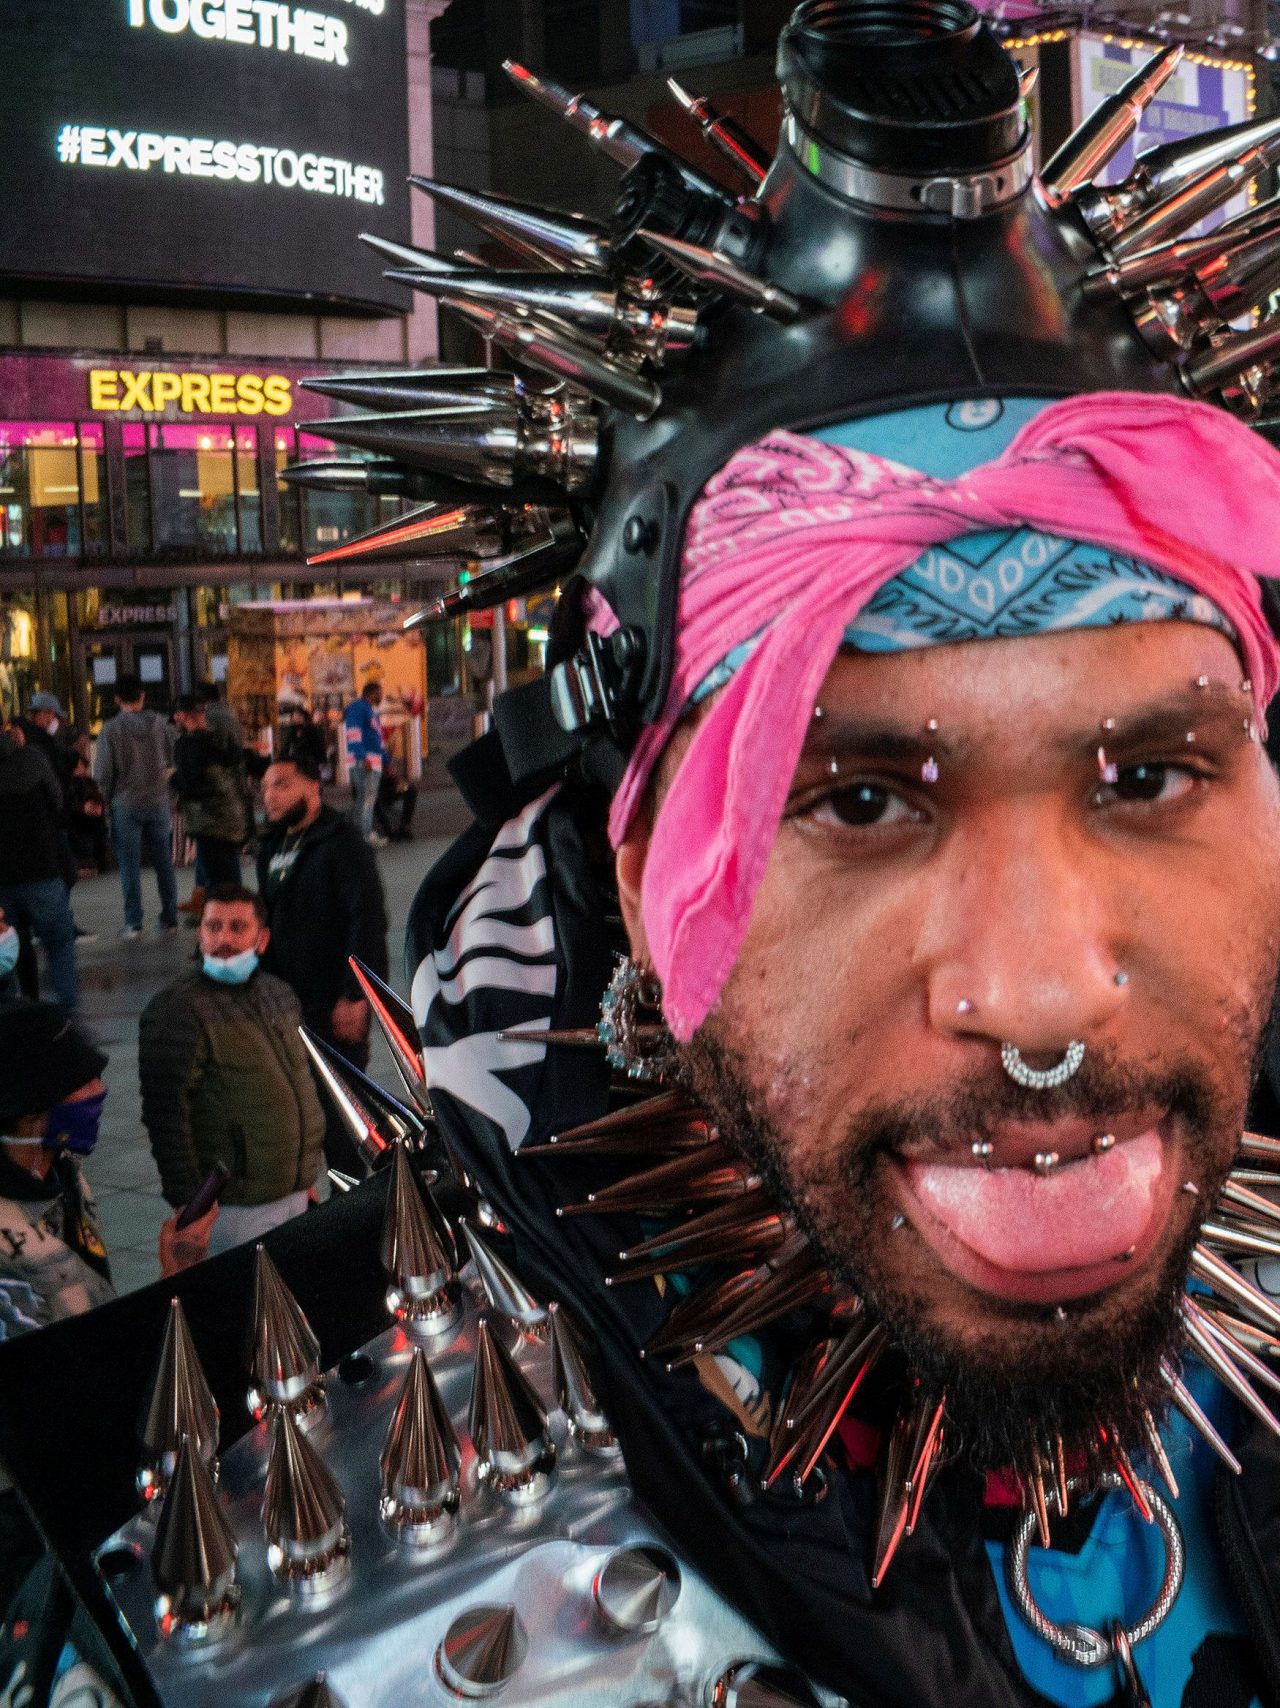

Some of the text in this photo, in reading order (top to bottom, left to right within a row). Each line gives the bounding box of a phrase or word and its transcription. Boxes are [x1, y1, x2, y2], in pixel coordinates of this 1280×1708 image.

[127, 0, 350, 66] TOGETHER
[57, 125, 386, 206] #EXPRESSTOGETHER
[90, 369, 293, 416] EXPRESS
